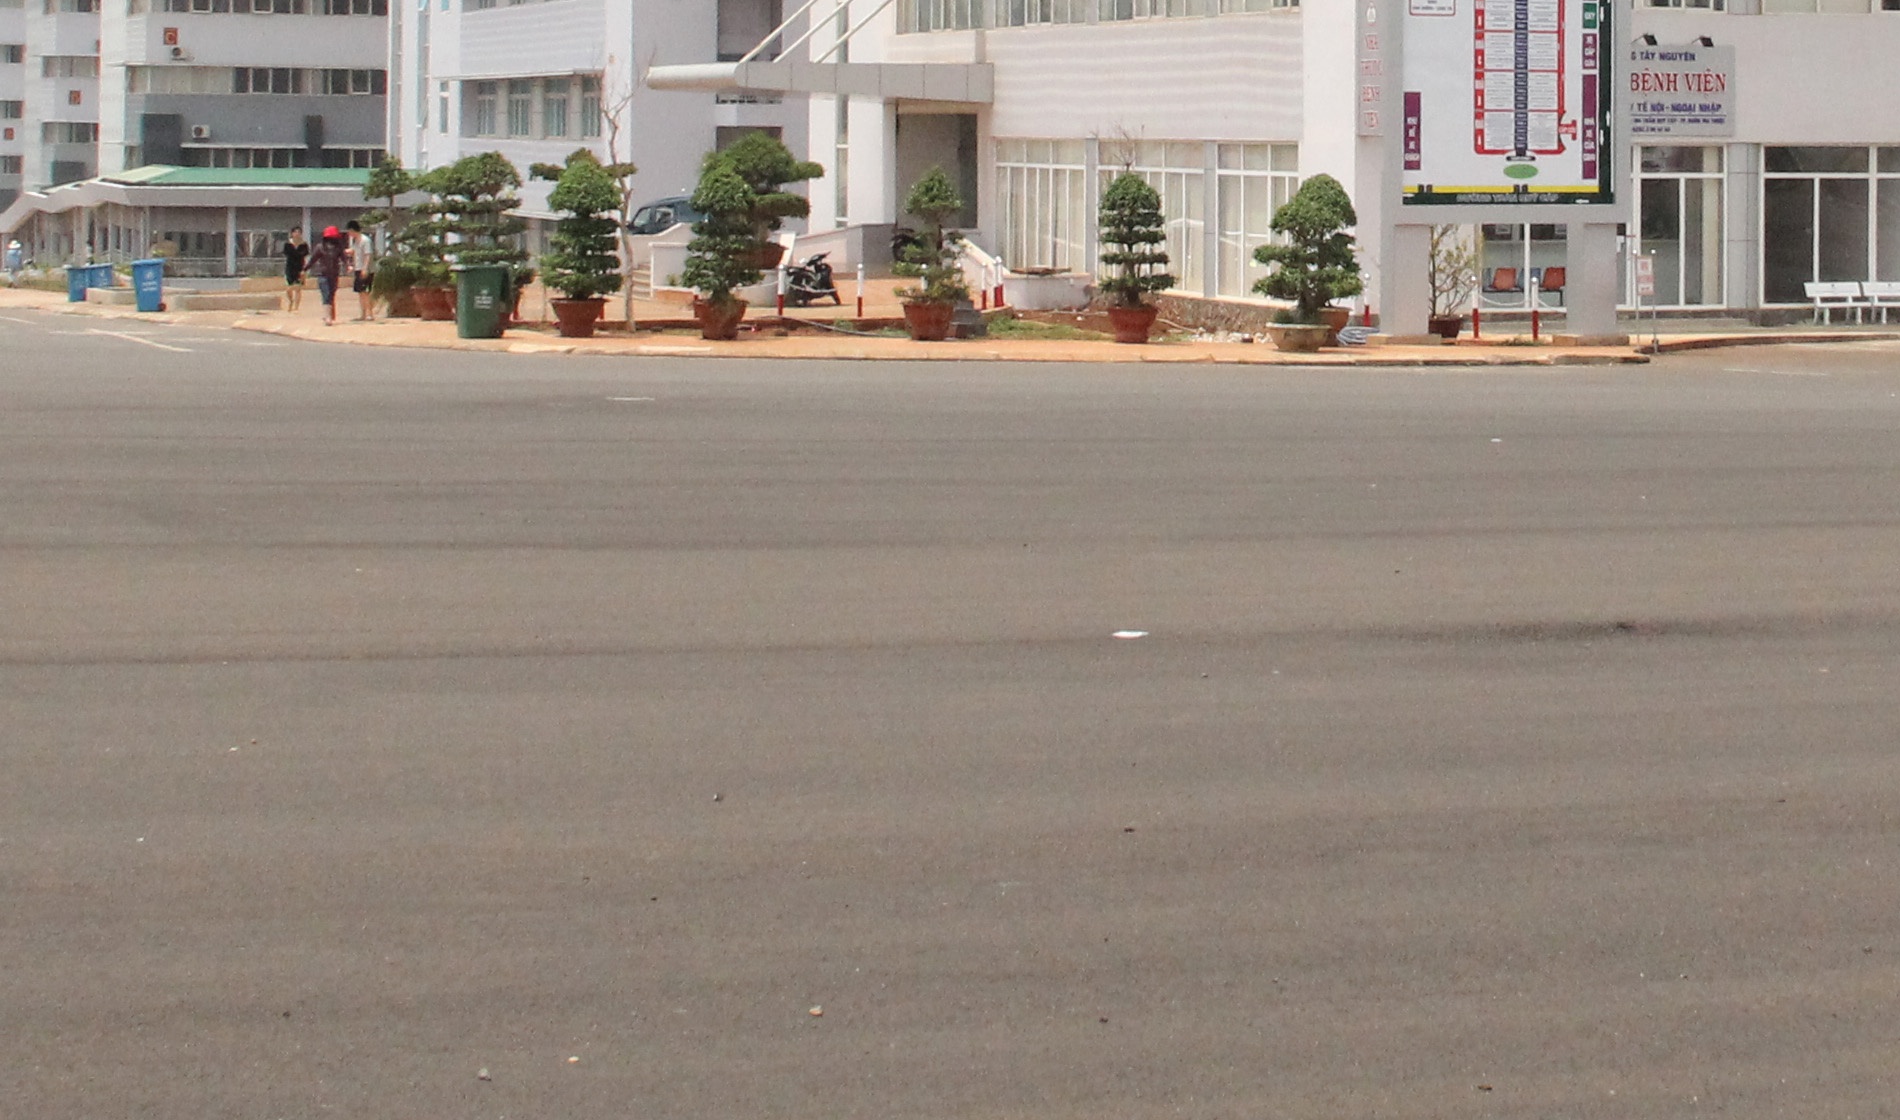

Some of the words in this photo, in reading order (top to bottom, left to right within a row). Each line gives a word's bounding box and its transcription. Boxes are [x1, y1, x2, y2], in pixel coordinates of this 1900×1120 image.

[1659, 51, 1696, 61] NGUYÊN
[1630, 67, 1678, 97] BỆNH
[1684, 67, 1727, 97] VIỆN
